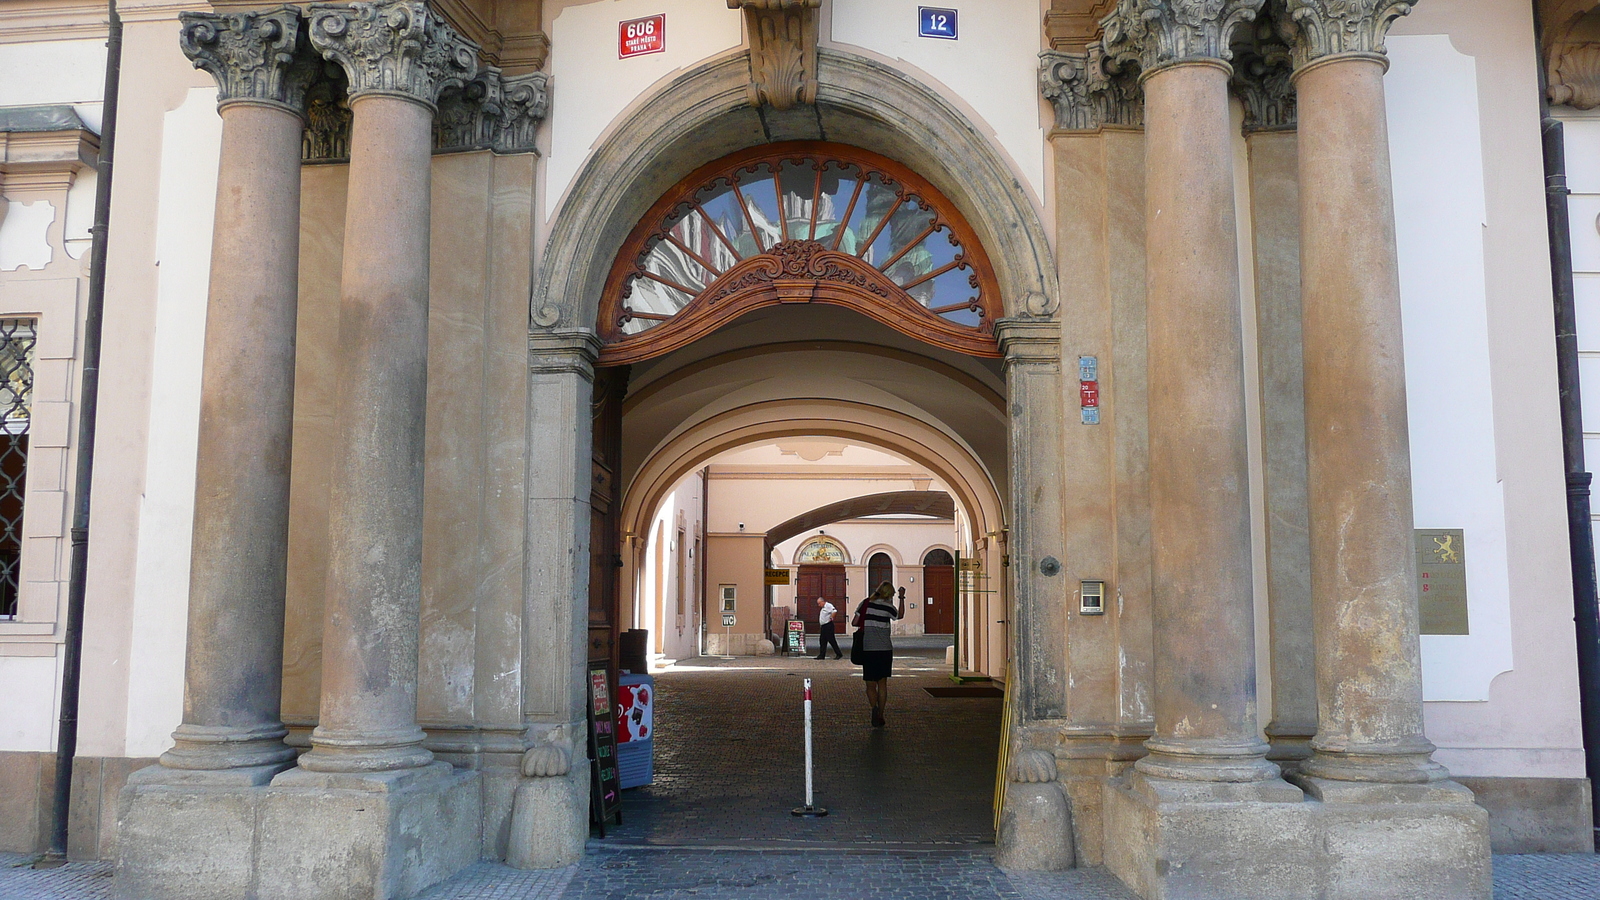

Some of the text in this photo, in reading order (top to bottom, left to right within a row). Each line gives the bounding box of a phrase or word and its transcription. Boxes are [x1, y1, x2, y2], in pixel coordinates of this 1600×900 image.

[931, 14, 947, 30] 12
[628, 20, 654, 38] 606
[626, 36, 656, 47] STARÉ MĚSTO
[722, 616, 734, 625] WC
